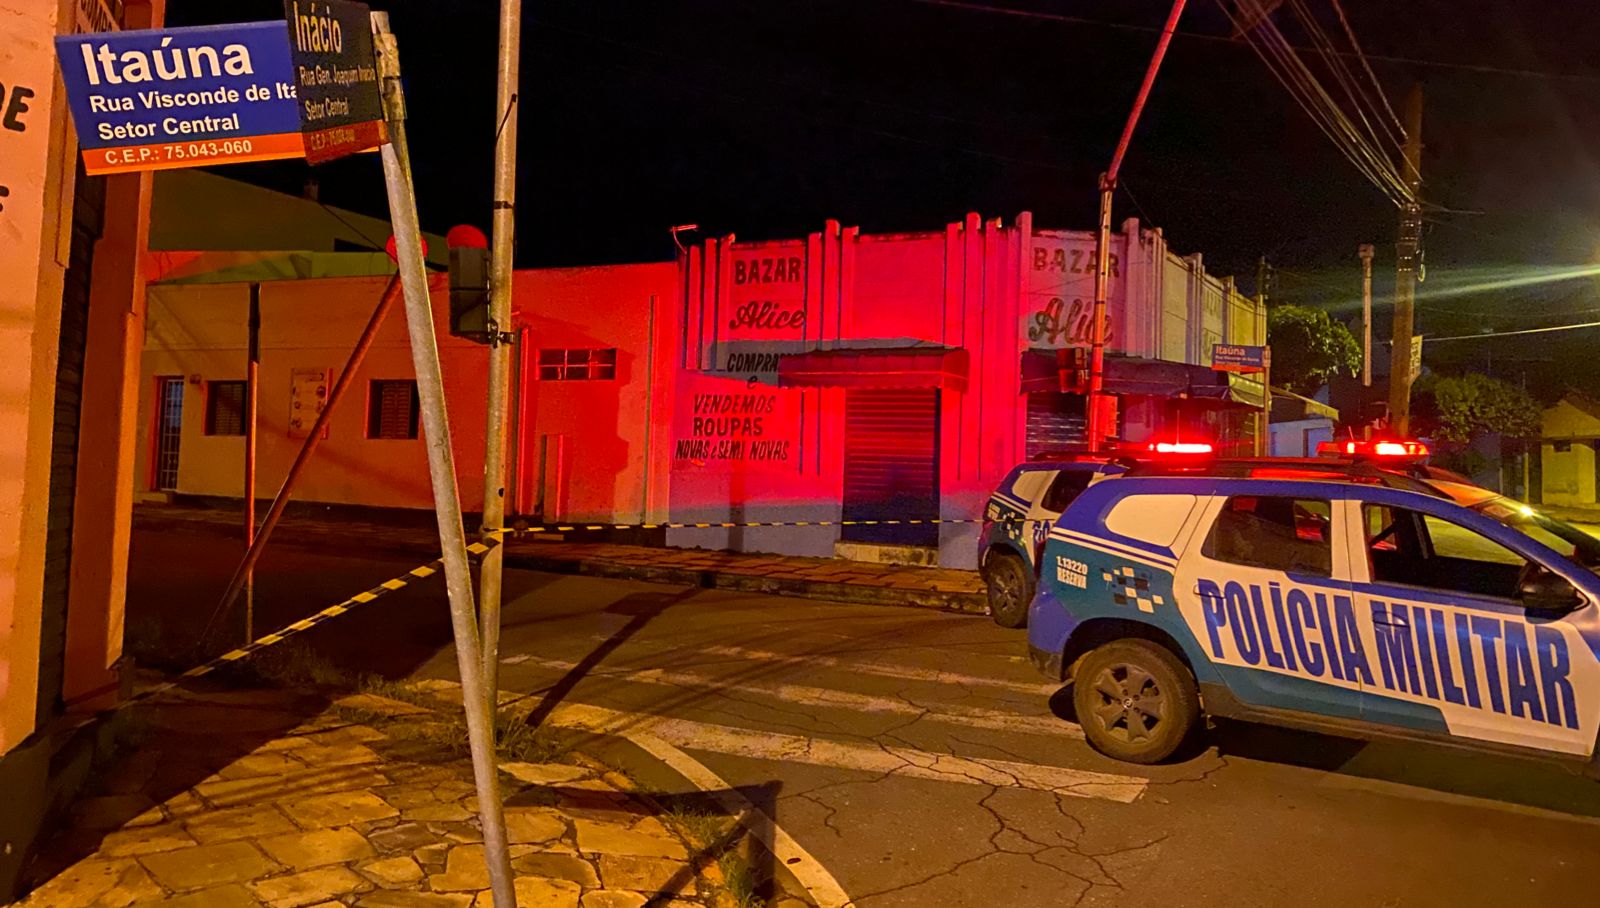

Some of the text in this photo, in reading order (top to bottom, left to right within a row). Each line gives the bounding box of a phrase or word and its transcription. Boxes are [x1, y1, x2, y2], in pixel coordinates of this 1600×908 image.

[293, 1, 342, 53] Inácio
[81, 37, 254, 86] Itaúna
[299, 65, 316, 86] Rua
[89, 82, 297, 113] Rua Visconde de Ita
[97, 113, 241, 140] Setor Central
[164, 139, 253, 160] 75.043-060
[734, 257, 802, 286] BAZAR
[1033, 247, 1119, 278] BAZAR
[728, 301, 805, 330] Alice
[726, 352, 788, 373] COMPRA
[1215, 345, 1246, 356] Itaúna
[693, 394, 777, 414] VENDEMOS
[692, 417, 763, 437] ROUPAS
[675, 439, 711, 460] NOVAS
[748, 441, 790, 461] NOVAS
[1198, 578, 1580, 731] POLÍCIA MILITAR
